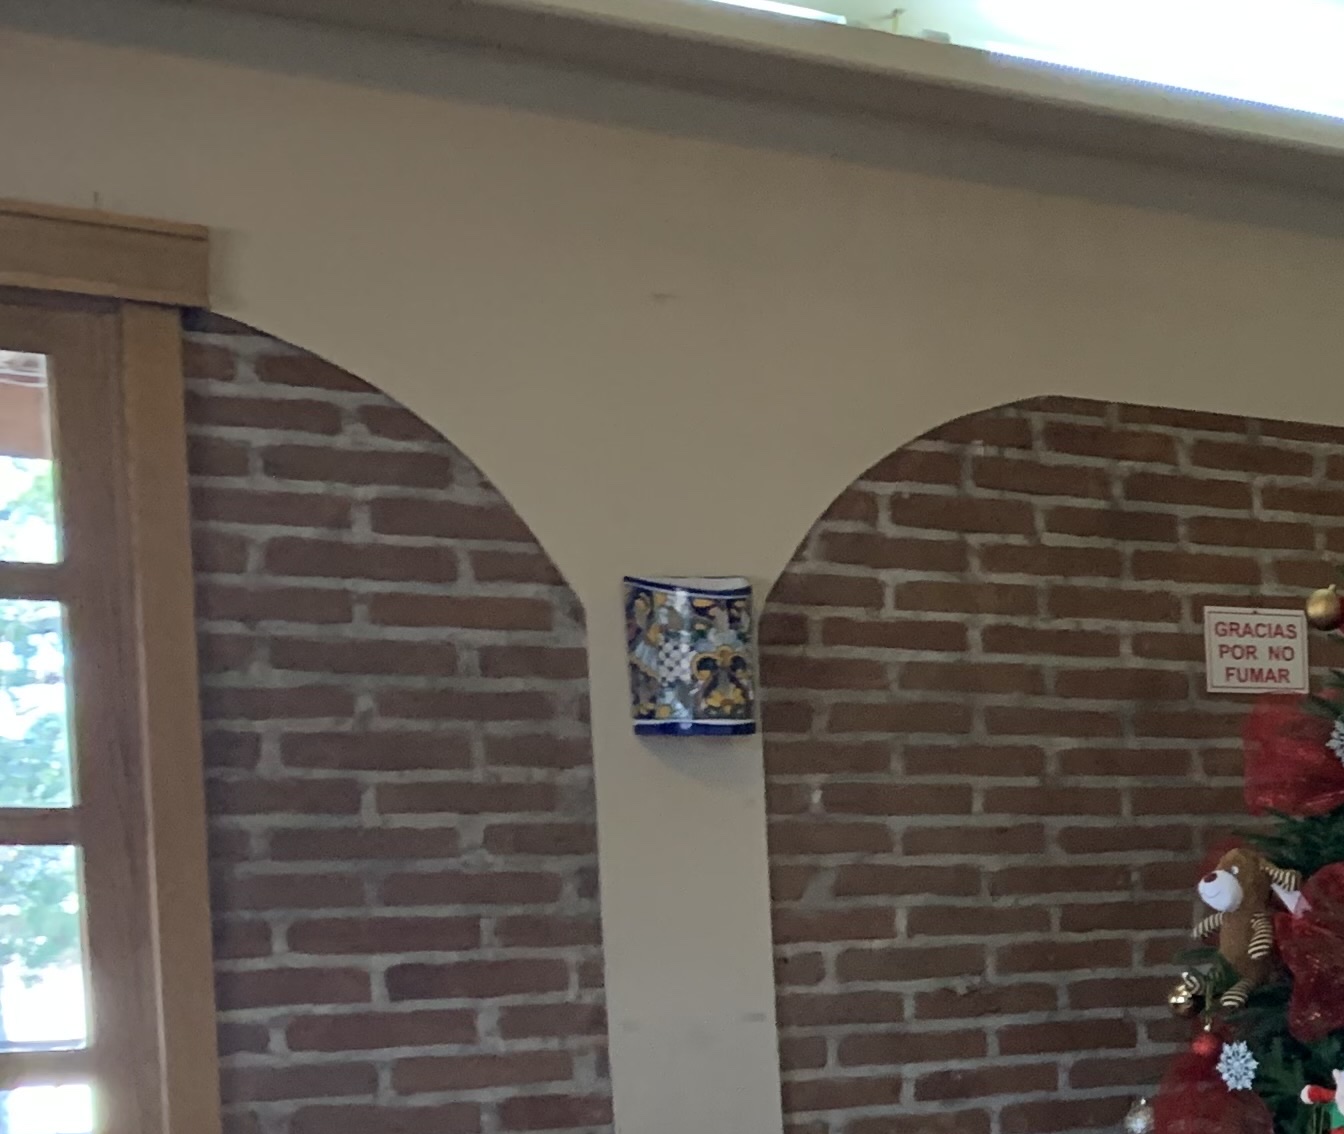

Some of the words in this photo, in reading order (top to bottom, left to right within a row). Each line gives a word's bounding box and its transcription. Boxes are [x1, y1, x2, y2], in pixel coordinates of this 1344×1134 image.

[1214, 621, 1297, 639] GRACIAS
[1218, 644, 1258, 660] POR
[1268, 645, 1295, 661] NO
[1225, 666, 1290, 683] FUMAR
